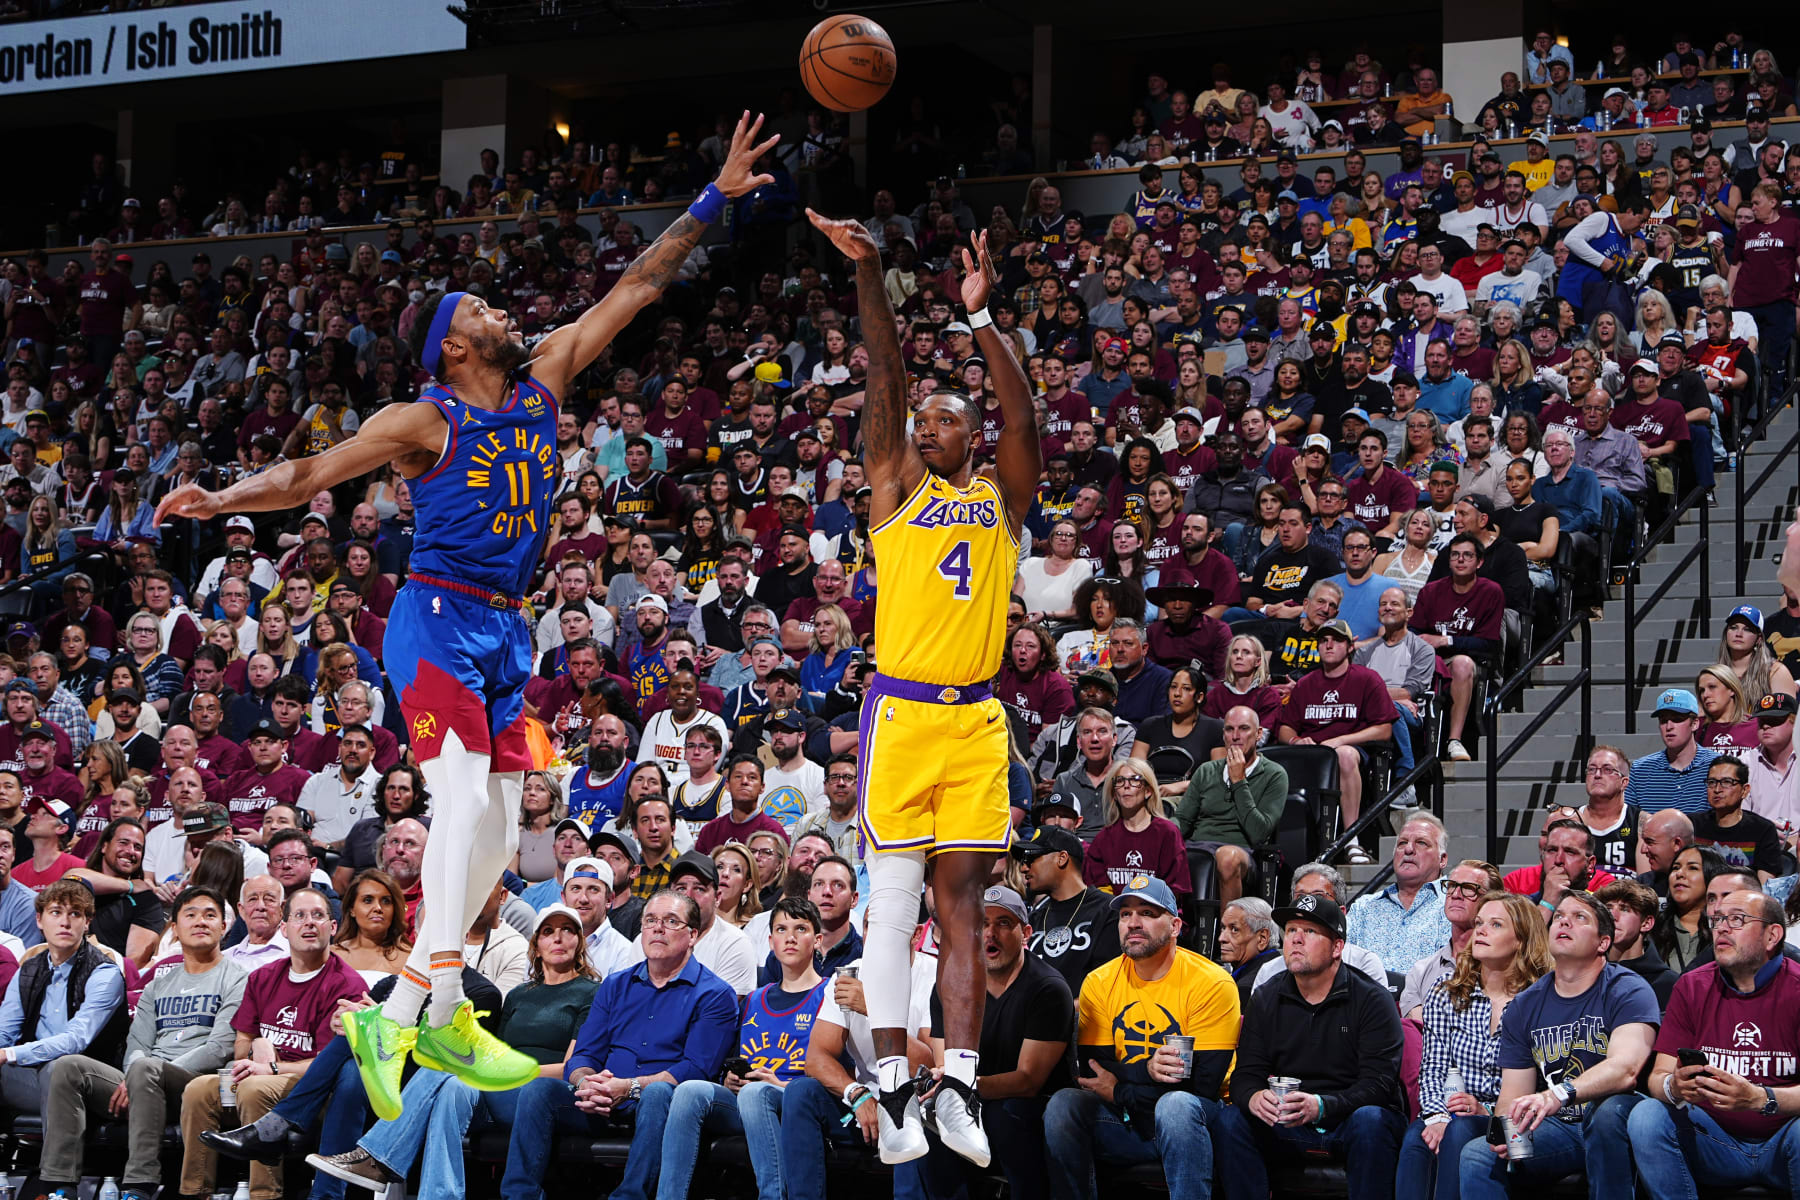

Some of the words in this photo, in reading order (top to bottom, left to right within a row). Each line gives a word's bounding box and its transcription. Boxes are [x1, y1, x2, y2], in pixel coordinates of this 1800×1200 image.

[102, 26, 116, 74] /
[126, 22, 176, 71] Ish
[188, 9, 282, 64] Smith
[1683, 268, 1701, 288] 15
[1713, 356, 1730, 371] 27
[521, 393, 542, 408] WU
[467, 432, 507, 487] MILE
[514, 427, 554, 480] HIGH
[504, 461, 530, 506] 11
[616, 500, 655, 514] DENVER
[908, 497, 998, 529] LAKERS
[492, 509, 538, 538] CITY
[688, 561, 719, 585] DEN
[936, 540, 973, 601] 4
[640, 676, 654, 697] 15
[1345, 705, 1358, 719] IN
[1604, 841, 1626, 866] 15
[155, 994, 222, 1017] NUGGETS
[163, 1017, 202, 1028] BASKETBALL
[796, 1013, 812, 1022] WU
[777, 1031, 806, 1071] HIGH
[1714, 1047, 1739, 1056] WESTERN
[1775, 1056, 1797, 1077] IN
